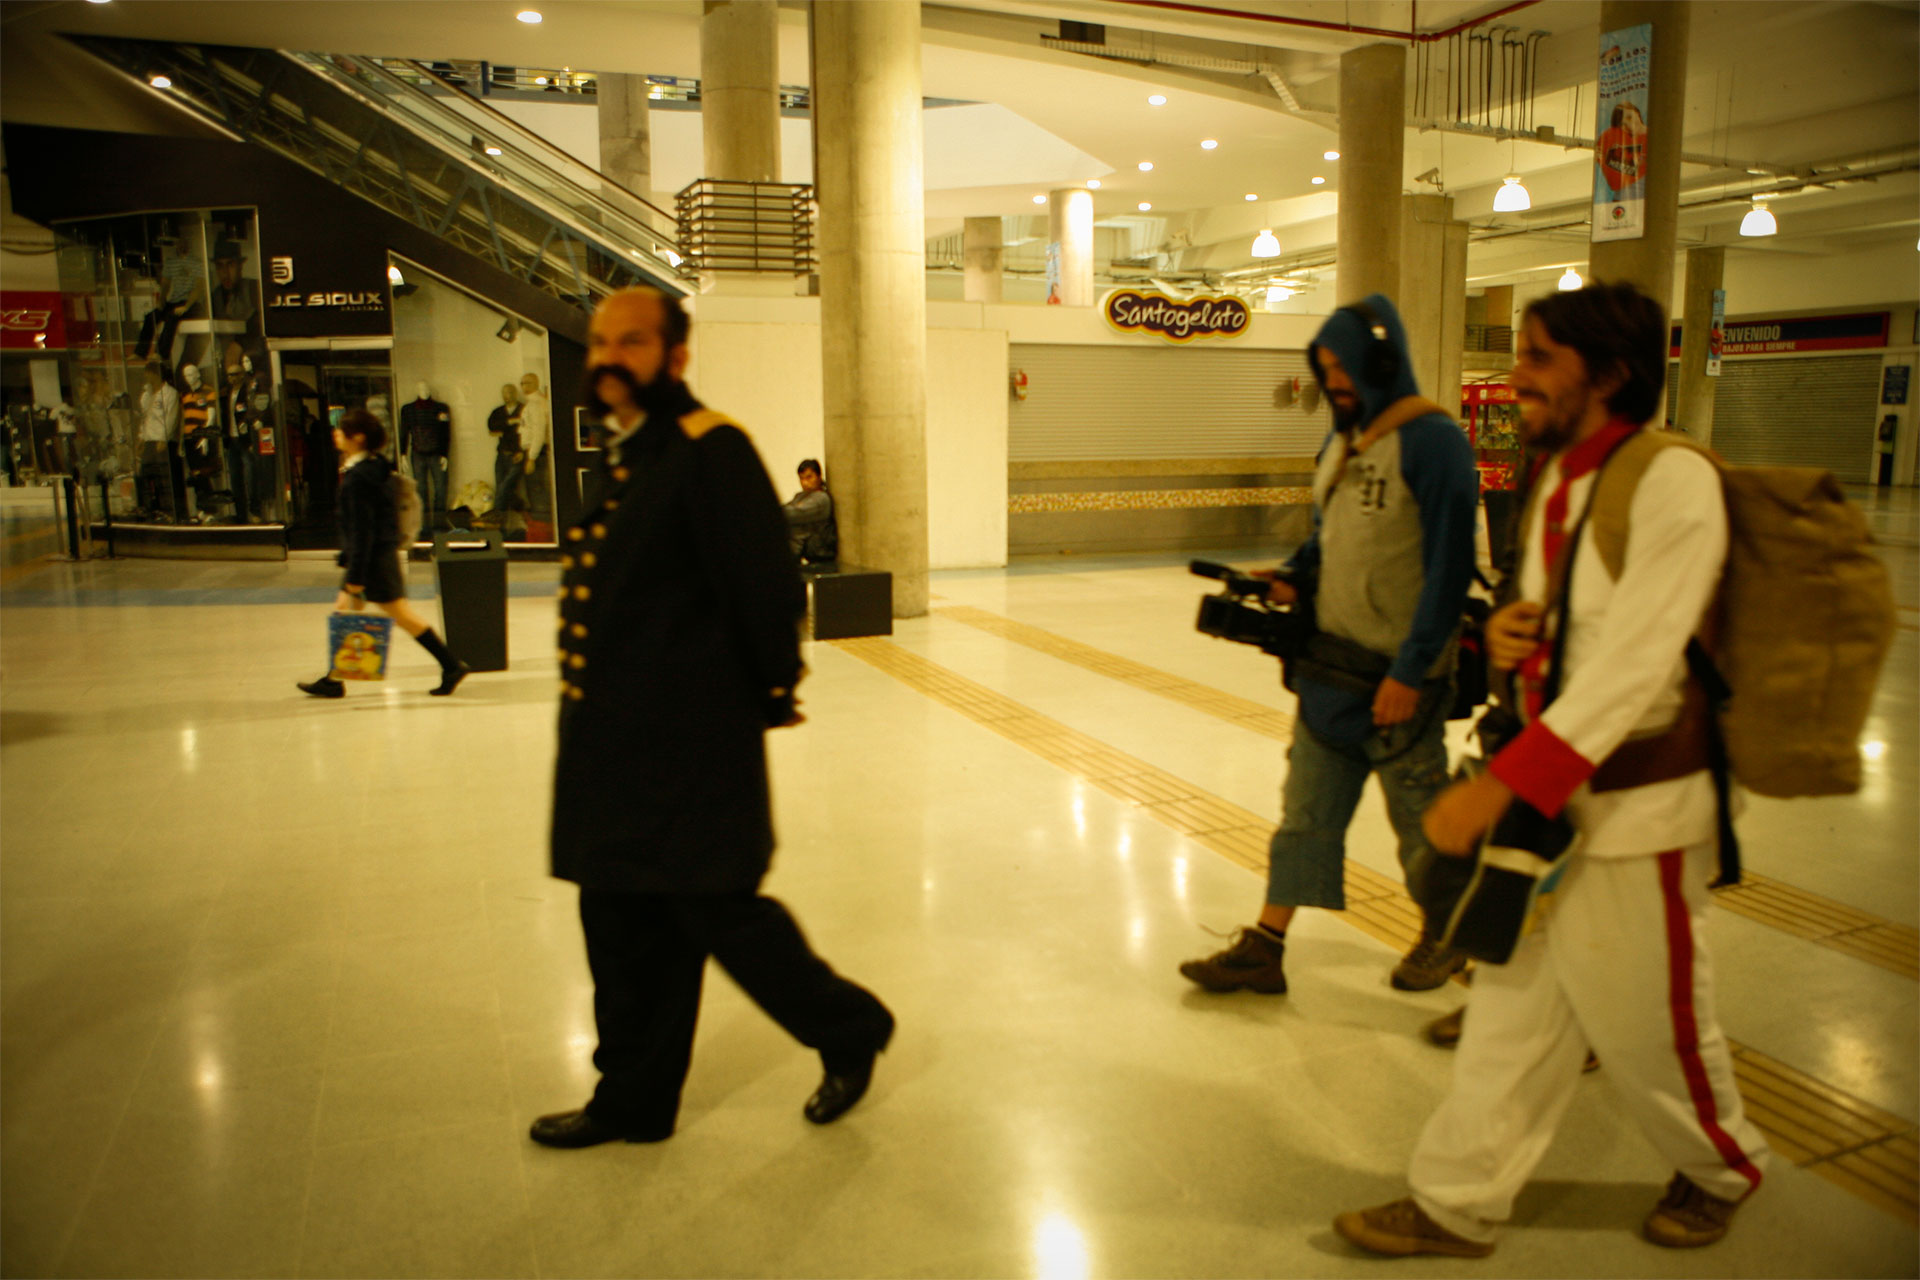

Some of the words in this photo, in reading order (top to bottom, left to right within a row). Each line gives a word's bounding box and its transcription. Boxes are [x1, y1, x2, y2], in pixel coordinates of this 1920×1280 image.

[269, 294, 302, 307] J.C
[307, 292, 383, 306] SIOUX
[1114, 296, 1246, 336] Santogelato
[1745, 342, 1764, 352] PARA
[1765, 341, 1797, 351] SIEMPRE
